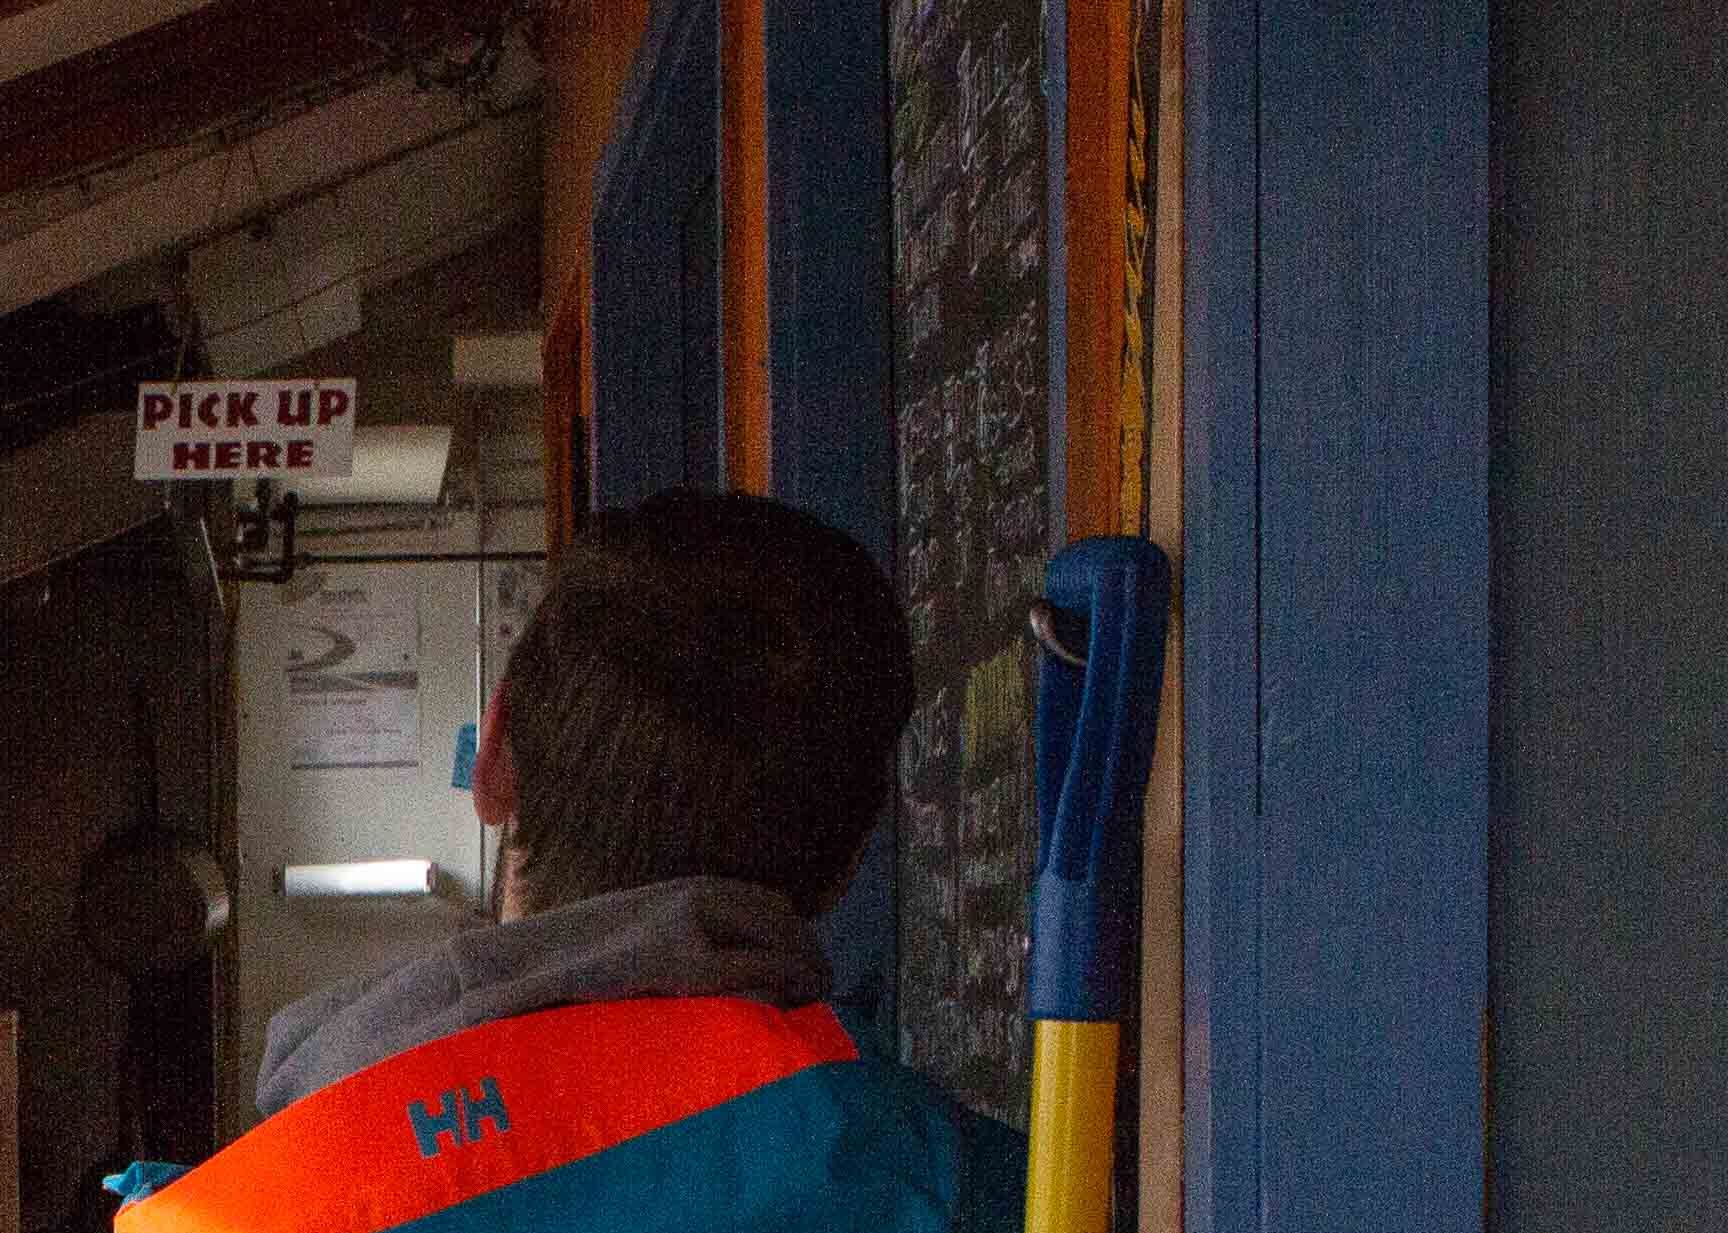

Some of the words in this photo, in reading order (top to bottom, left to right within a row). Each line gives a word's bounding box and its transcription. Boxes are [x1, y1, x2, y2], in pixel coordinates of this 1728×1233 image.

[142, 392, 260, 430] PICK
[277, 389, 348, 427] UP
[172, 441, 314, 470] HERE
[407, 1077, 511, 1159] HH
